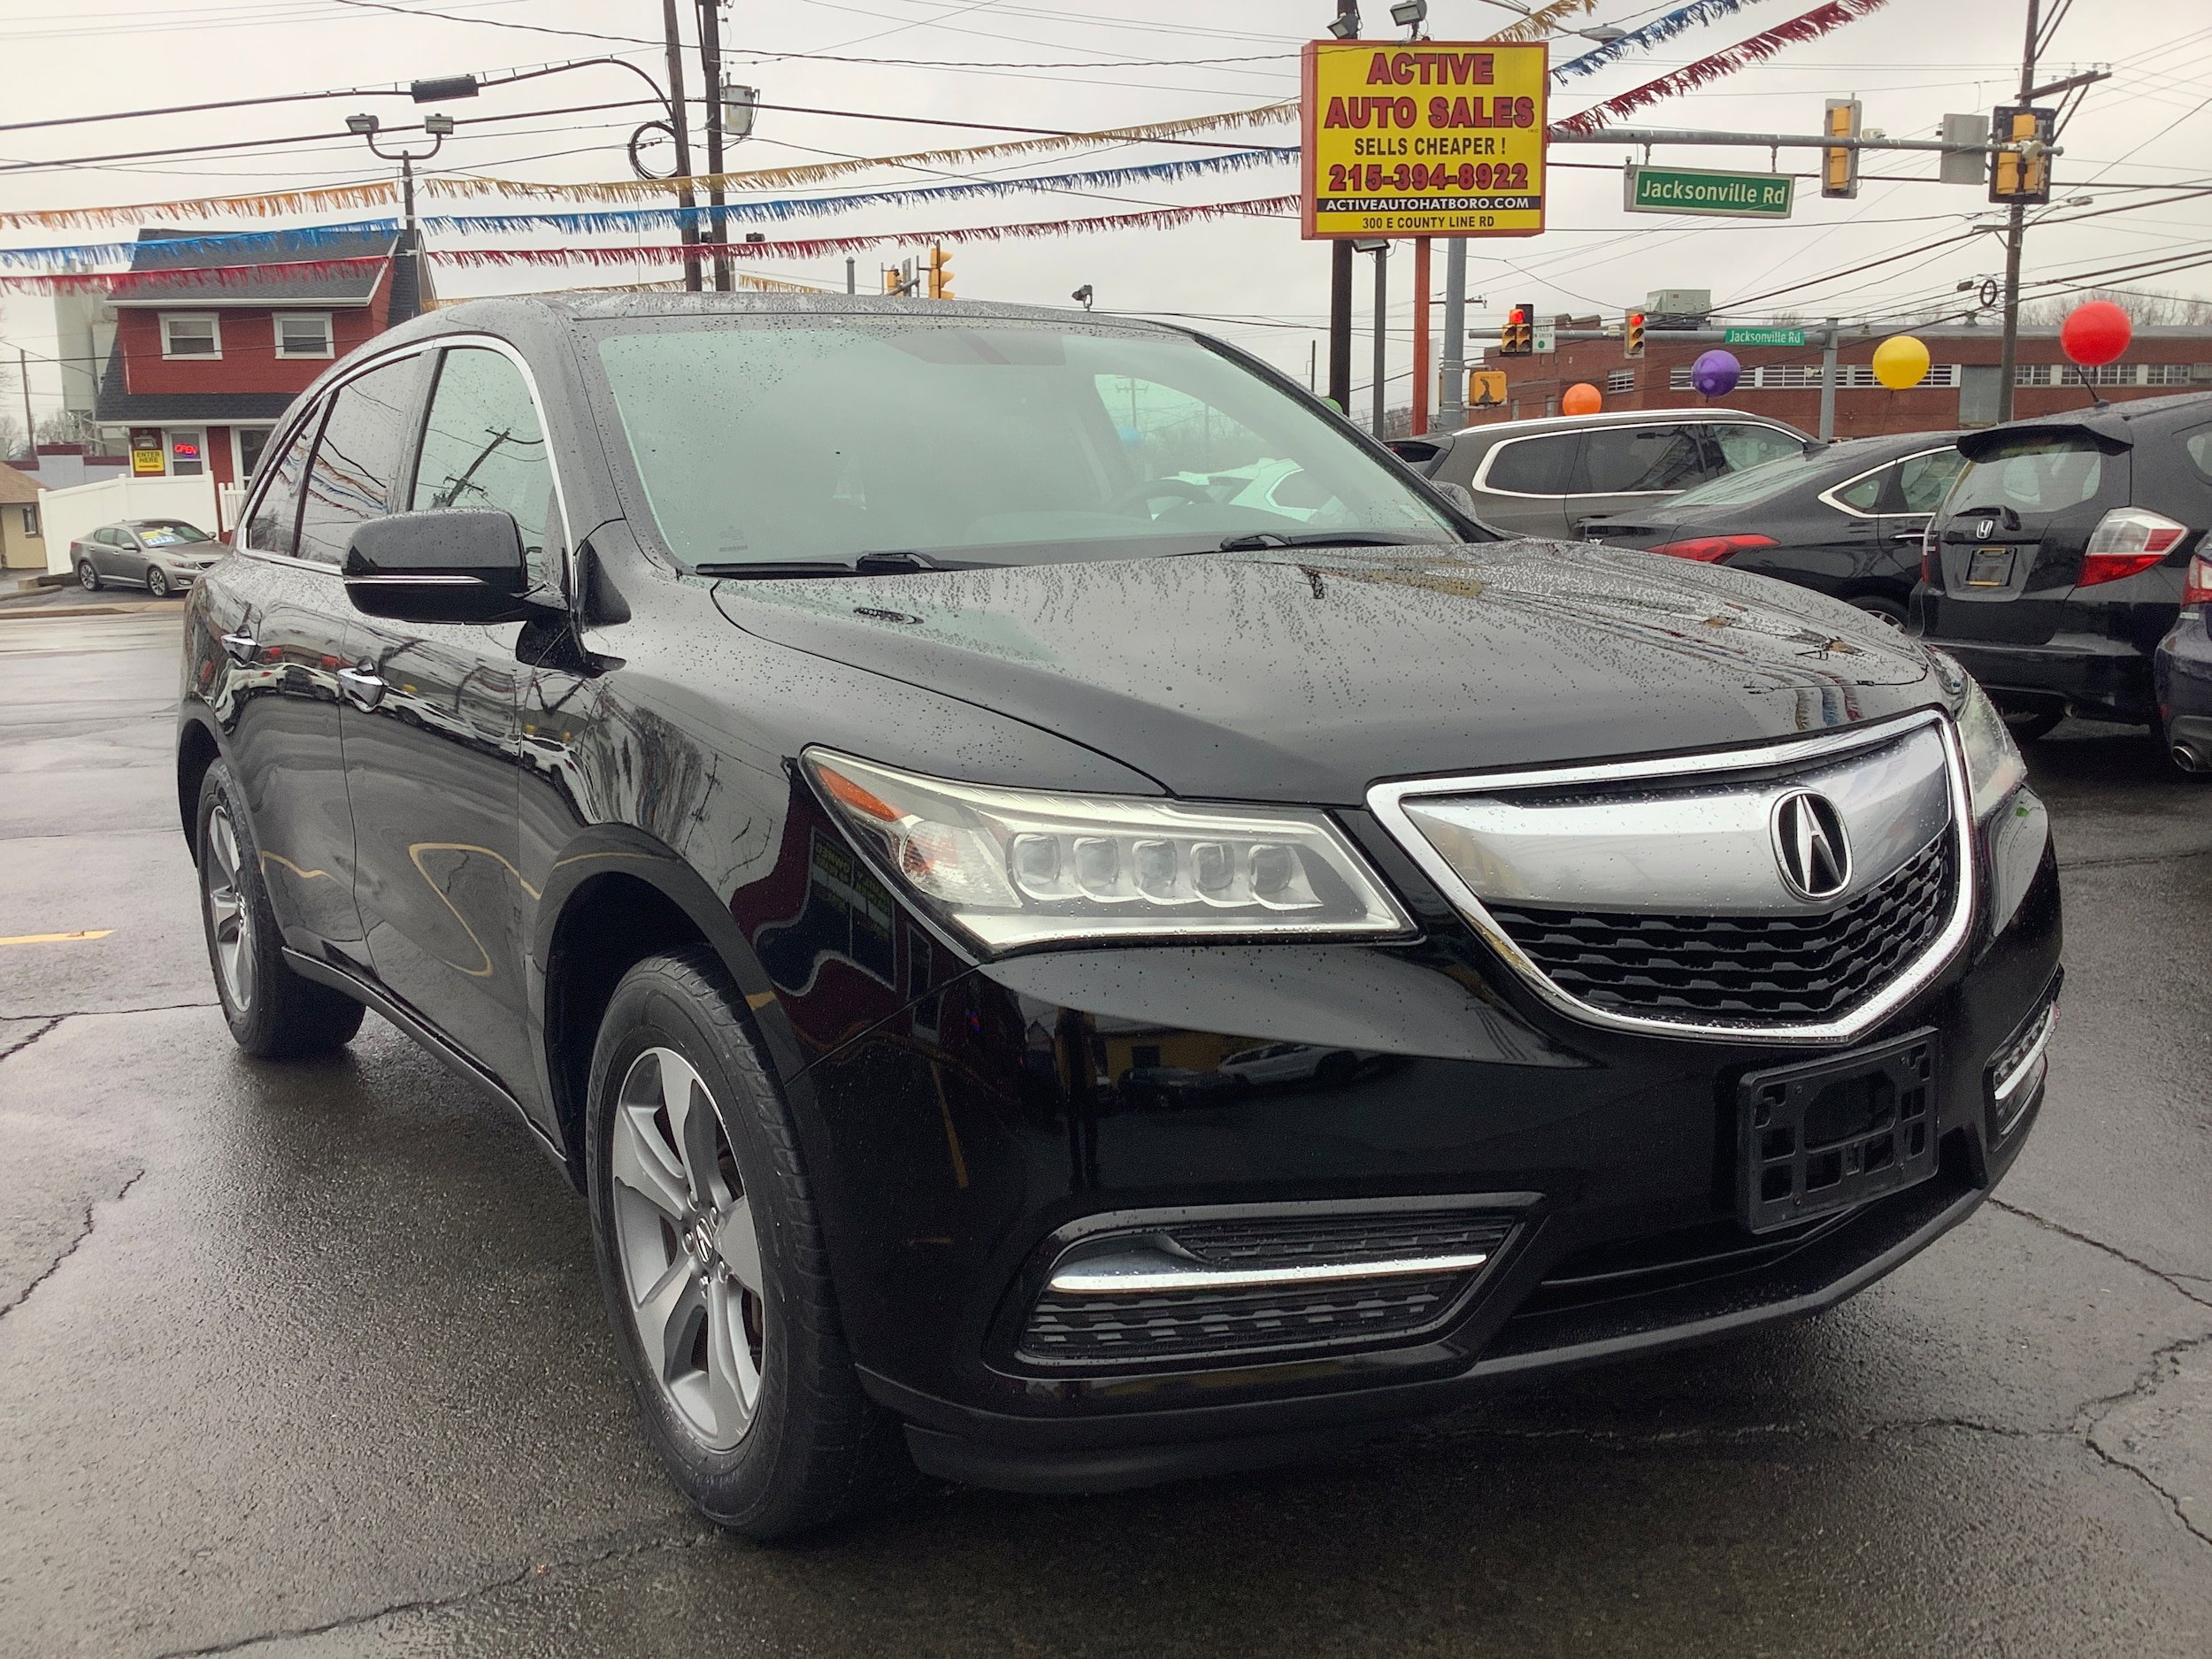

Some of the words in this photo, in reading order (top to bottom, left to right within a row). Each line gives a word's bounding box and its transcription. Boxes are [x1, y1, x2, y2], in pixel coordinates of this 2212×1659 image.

[1366, 52, 1494, 85] ACTIVE
[1324, 96, 1417, 129] AUTO
[1428, 96, 1534, 129] SALES
[1355, 137, 1408, 156] SELLS
[1415, 137, 1495, 155] CHEAPER
[1328, 163, 1528, 192] 215-394-8922
[1641, 180, 1757, 204] Jacksonville
[1763, 186, 1786, 204] Rd
[1326, 197, 1529, 211] ACTIVEAUTOHATBORO.COM
[1363, 217, 1382, 229] 300
[1386, 218, 1394, 228] E
[1397, 217, 1446, 228] COUNTY
[1449, 216, 1476, 227] LINE
[1479, 216, 1494, 227] RD
[1729, 330, 1786, 343] Jacksonville
[1788, 331, 1801, 343] Rd
[174, 444, 198, 455] OPEN
